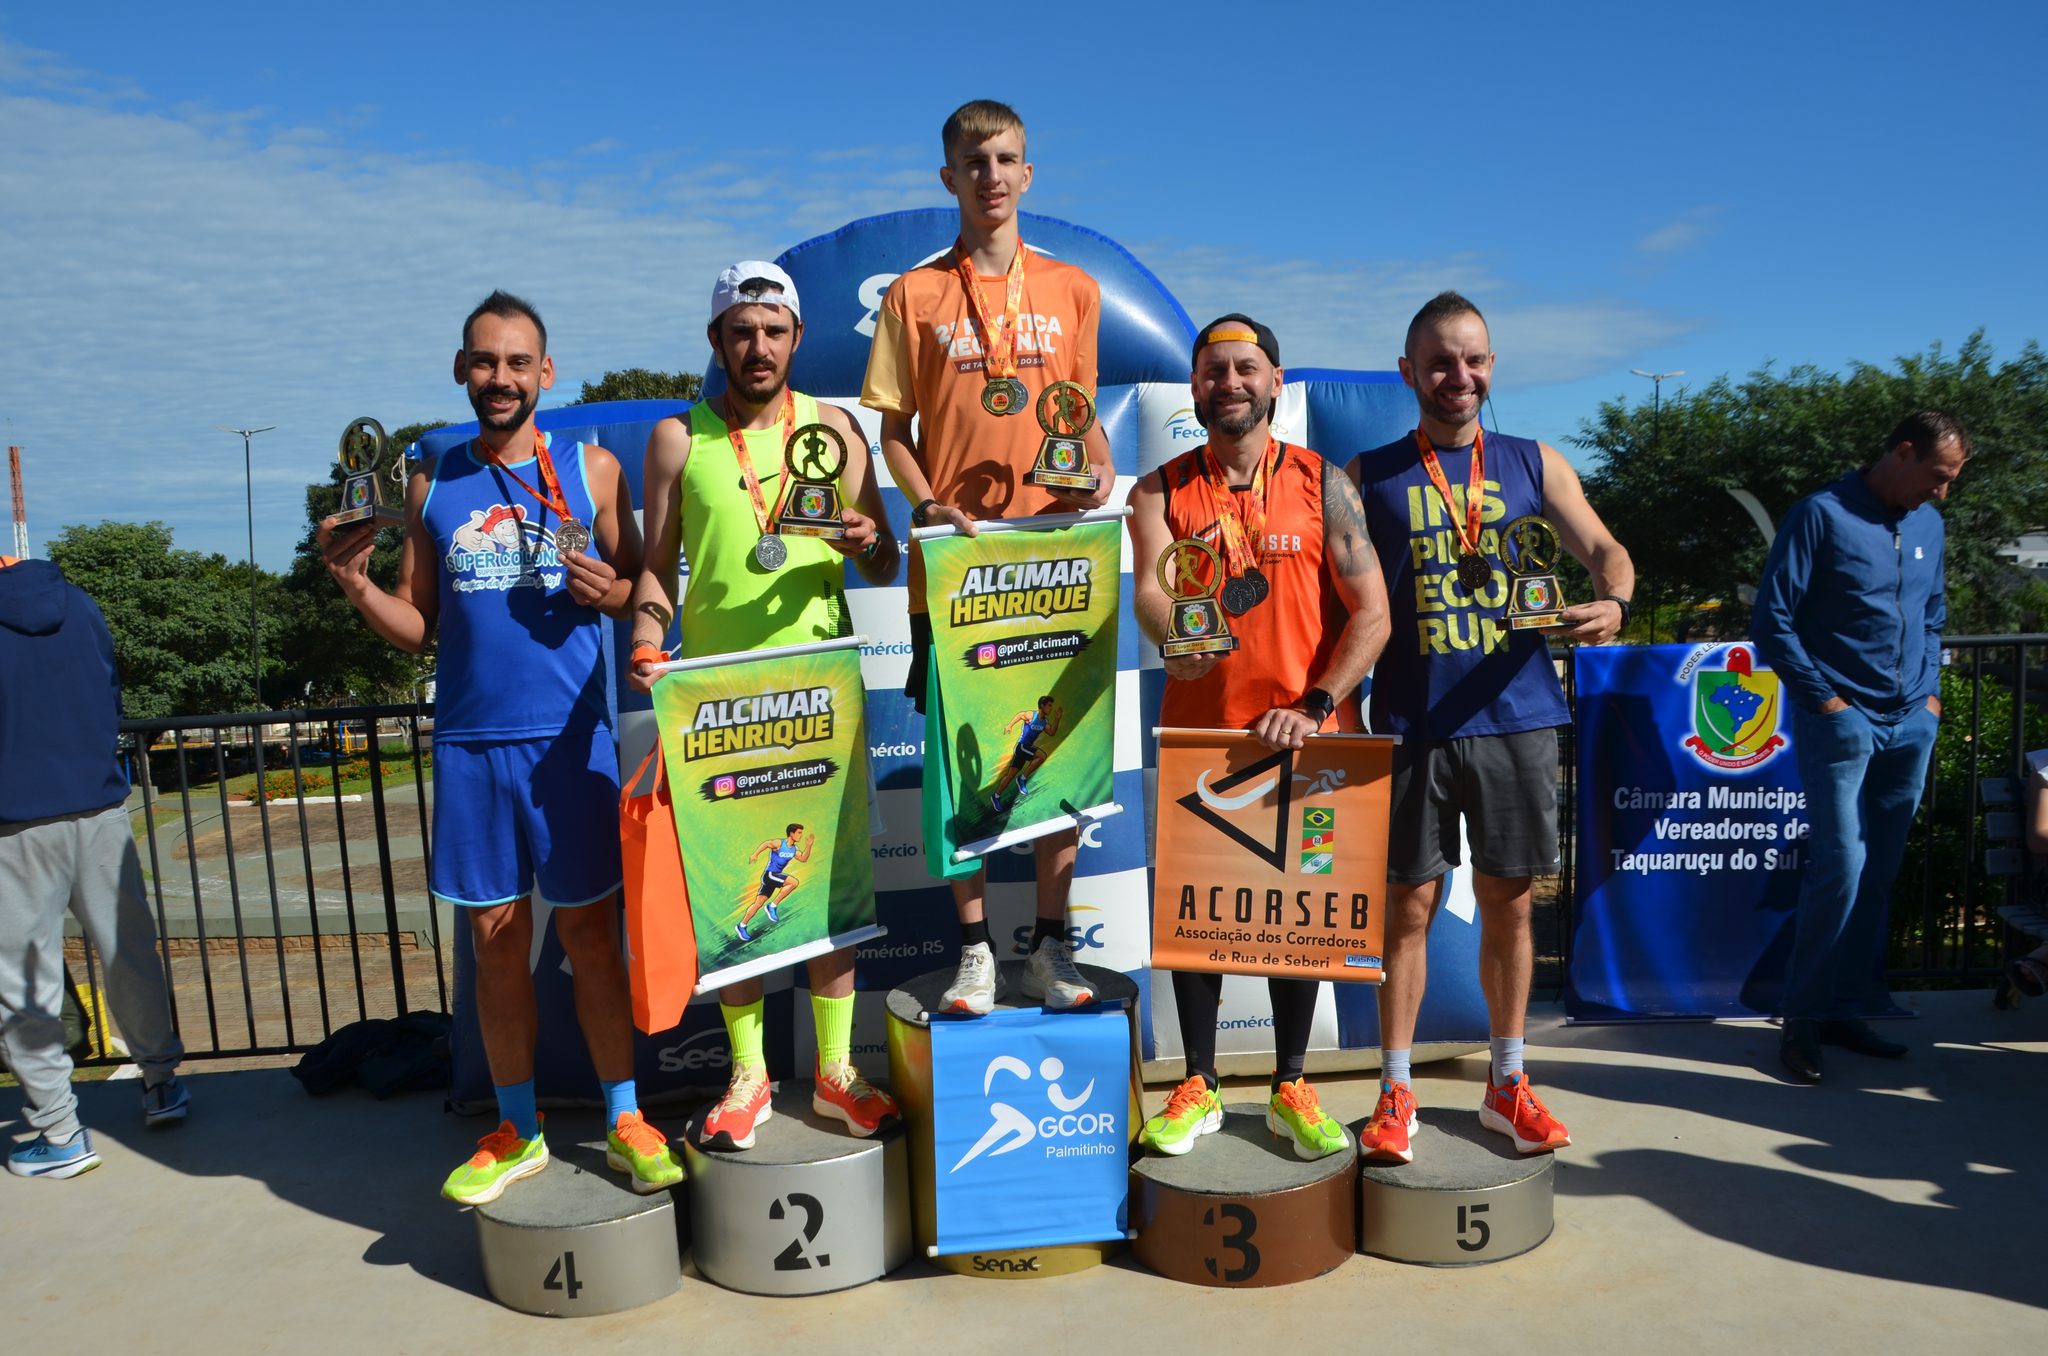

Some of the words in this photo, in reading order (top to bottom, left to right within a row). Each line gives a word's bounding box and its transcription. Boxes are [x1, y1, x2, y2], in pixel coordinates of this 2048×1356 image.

[963, 313, 1062, 336] RSTICA
[1271, 422, 1289, 434] RS
[1407, 480, 1506, 531] INS
[447, 551, 496, 572] SUPER
[961, 559, 1088, 596] ALCIMAR
[1415, 569, 1508, 613] ECO
[953, 585, 1088, 624] HENRIQUE
[859, 640, 914, 656] mércio
[997, 635, 1079, 657] @prof_alcimarh
[1417, 612, 1510, 656] RUN
[1679, 651, 1703, 680] PODER
[695, 688, 829, 730] ALCIMAR
[687, 714, 830, 759] HENRIQUE
[737, 763, 827, 788] @prof_alcimarh
[1613, 786, 1701, 810] Câmara
[1707, 786, 1807, 815] Municipa
[1654, 817, 1778, 840] Vereadores
[1784, 818, 1811, 841] de
[1611, 848, 1724, 876] Taquaruçu
[1730, 848, 1757, 870] do
[1763, 848, 1798, 870] Sul
[1178, 884, 1369, 930] ACORSEB
[857, 942, 918, 959] mércio
[922, 940, 945, 955] RS
[1174, 925, 1252, 945] Associação
[1256, 930, 1282, 944] dos
[1286, 932, 1367, 949] Corredores
[1209, 950, 1227, 962] de
[1231, 951, 1257, 965] Rua
[1262, 953, 1280, 966] de
[1284, 954, 1330, 969] Seberi
[658, 1046, 731, 1072] Ses
[1038, 1113, 1115, 1139] GCOR
[1046, 1142, 1116, 1158] Palmitinho
[769, 1192, 831, 1272] 2
[1455, 1202, 1491, 1252] 5
[1202, 1203, 1261, 1282] 3
[542, 1250, 583, 1299] 4
[972, 1255, 1039, 1273] Senac
